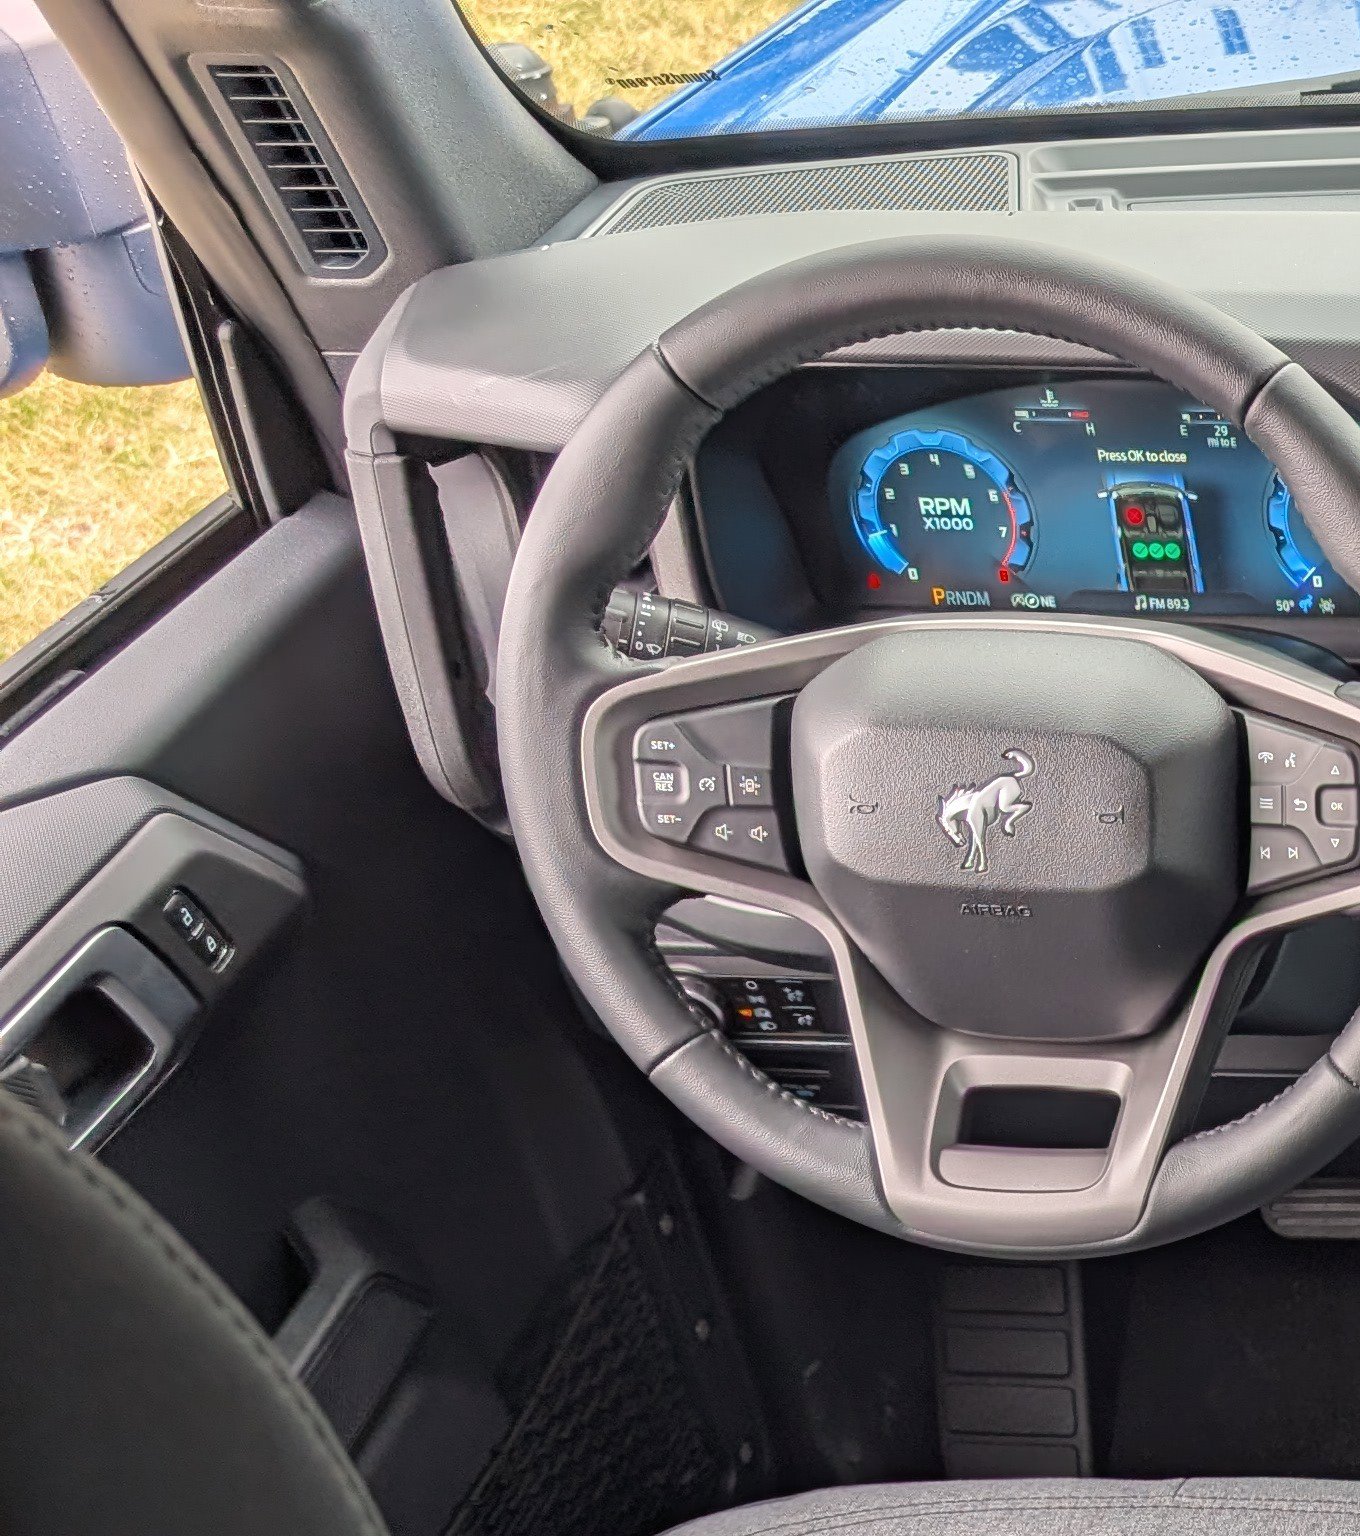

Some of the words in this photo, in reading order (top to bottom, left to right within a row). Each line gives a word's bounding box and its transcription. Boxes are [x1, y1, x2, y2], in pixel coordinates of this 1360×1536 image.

[1012, 421, 1022, 433] C
[1085, 423, 1096, 436] H
[1180, 425, 1188, 437] E
[1214, 424, 1228, 437] 29
[1220, 438, 1229, 447] to
[1230, 438, 1237, 447] E
[929, 454, 940, 466] 4
[1098, 449, 1127, 462] Press
[1129, 450, 1145, 462] OK
[1146, 451, 1158, 462] to
[1159, 451, 1187, 463] close
[899, 463, 910, 476] 3
[963, 463, 976, 479] 5
[884, 488, 895, 500] 2
[988, 489, 999, 502] 6
[918, 496, 972, 516] RPM
[890, 523, 899, 537] 1
[923, 517, 974, 531] X1000
[998, 526, 1008, 538] 7
[907, 567, 919, 581] 0
[1041, 595, 1056, 609] NE
[1149, 598, 1165, 610] FM
[1166, 598, 1190, 611] 89.3
[650, 741, 676, 750] SET+
[653, 772, 674, 781] CAN
[655, 783, 674, 792] RES
[1330, 802, 1344, 811] OK
[960, 903, 1033, 917] AIRBAG
